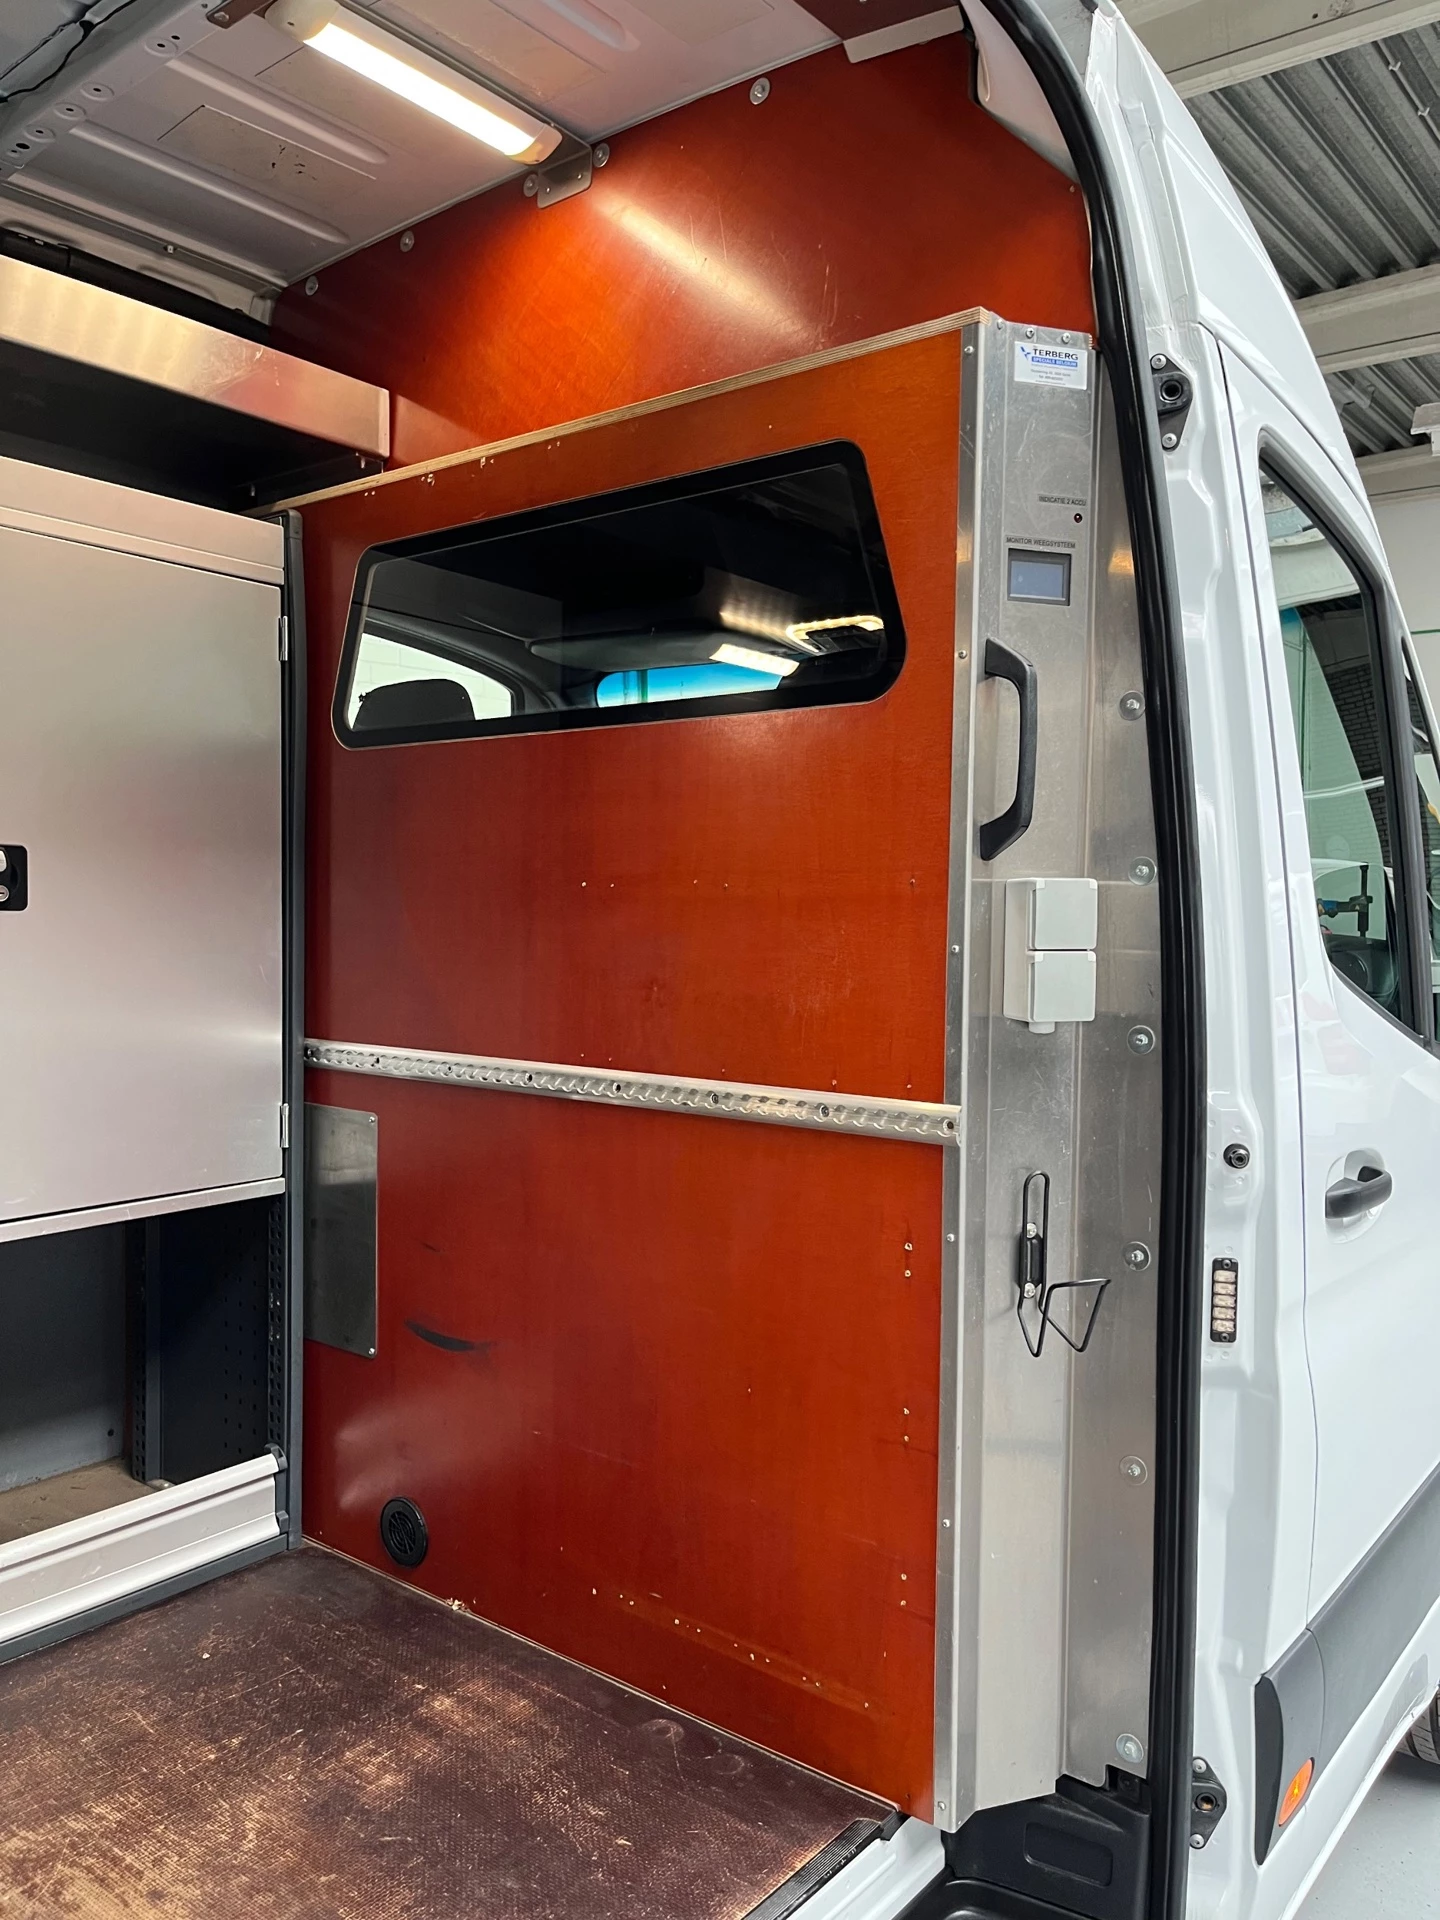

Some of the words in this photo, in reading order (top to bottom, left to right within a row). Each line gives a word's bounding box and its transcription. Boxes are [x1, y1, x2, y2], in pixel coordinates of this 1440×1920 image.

[1033, 348, 1078, 360] TERBERG
[1039, 496, 1066, 504] INDICATIE
[1006, 537, 1032, 545] MONITOR
[1033, 539, 1075, 548] WEEGSYSTEEM
